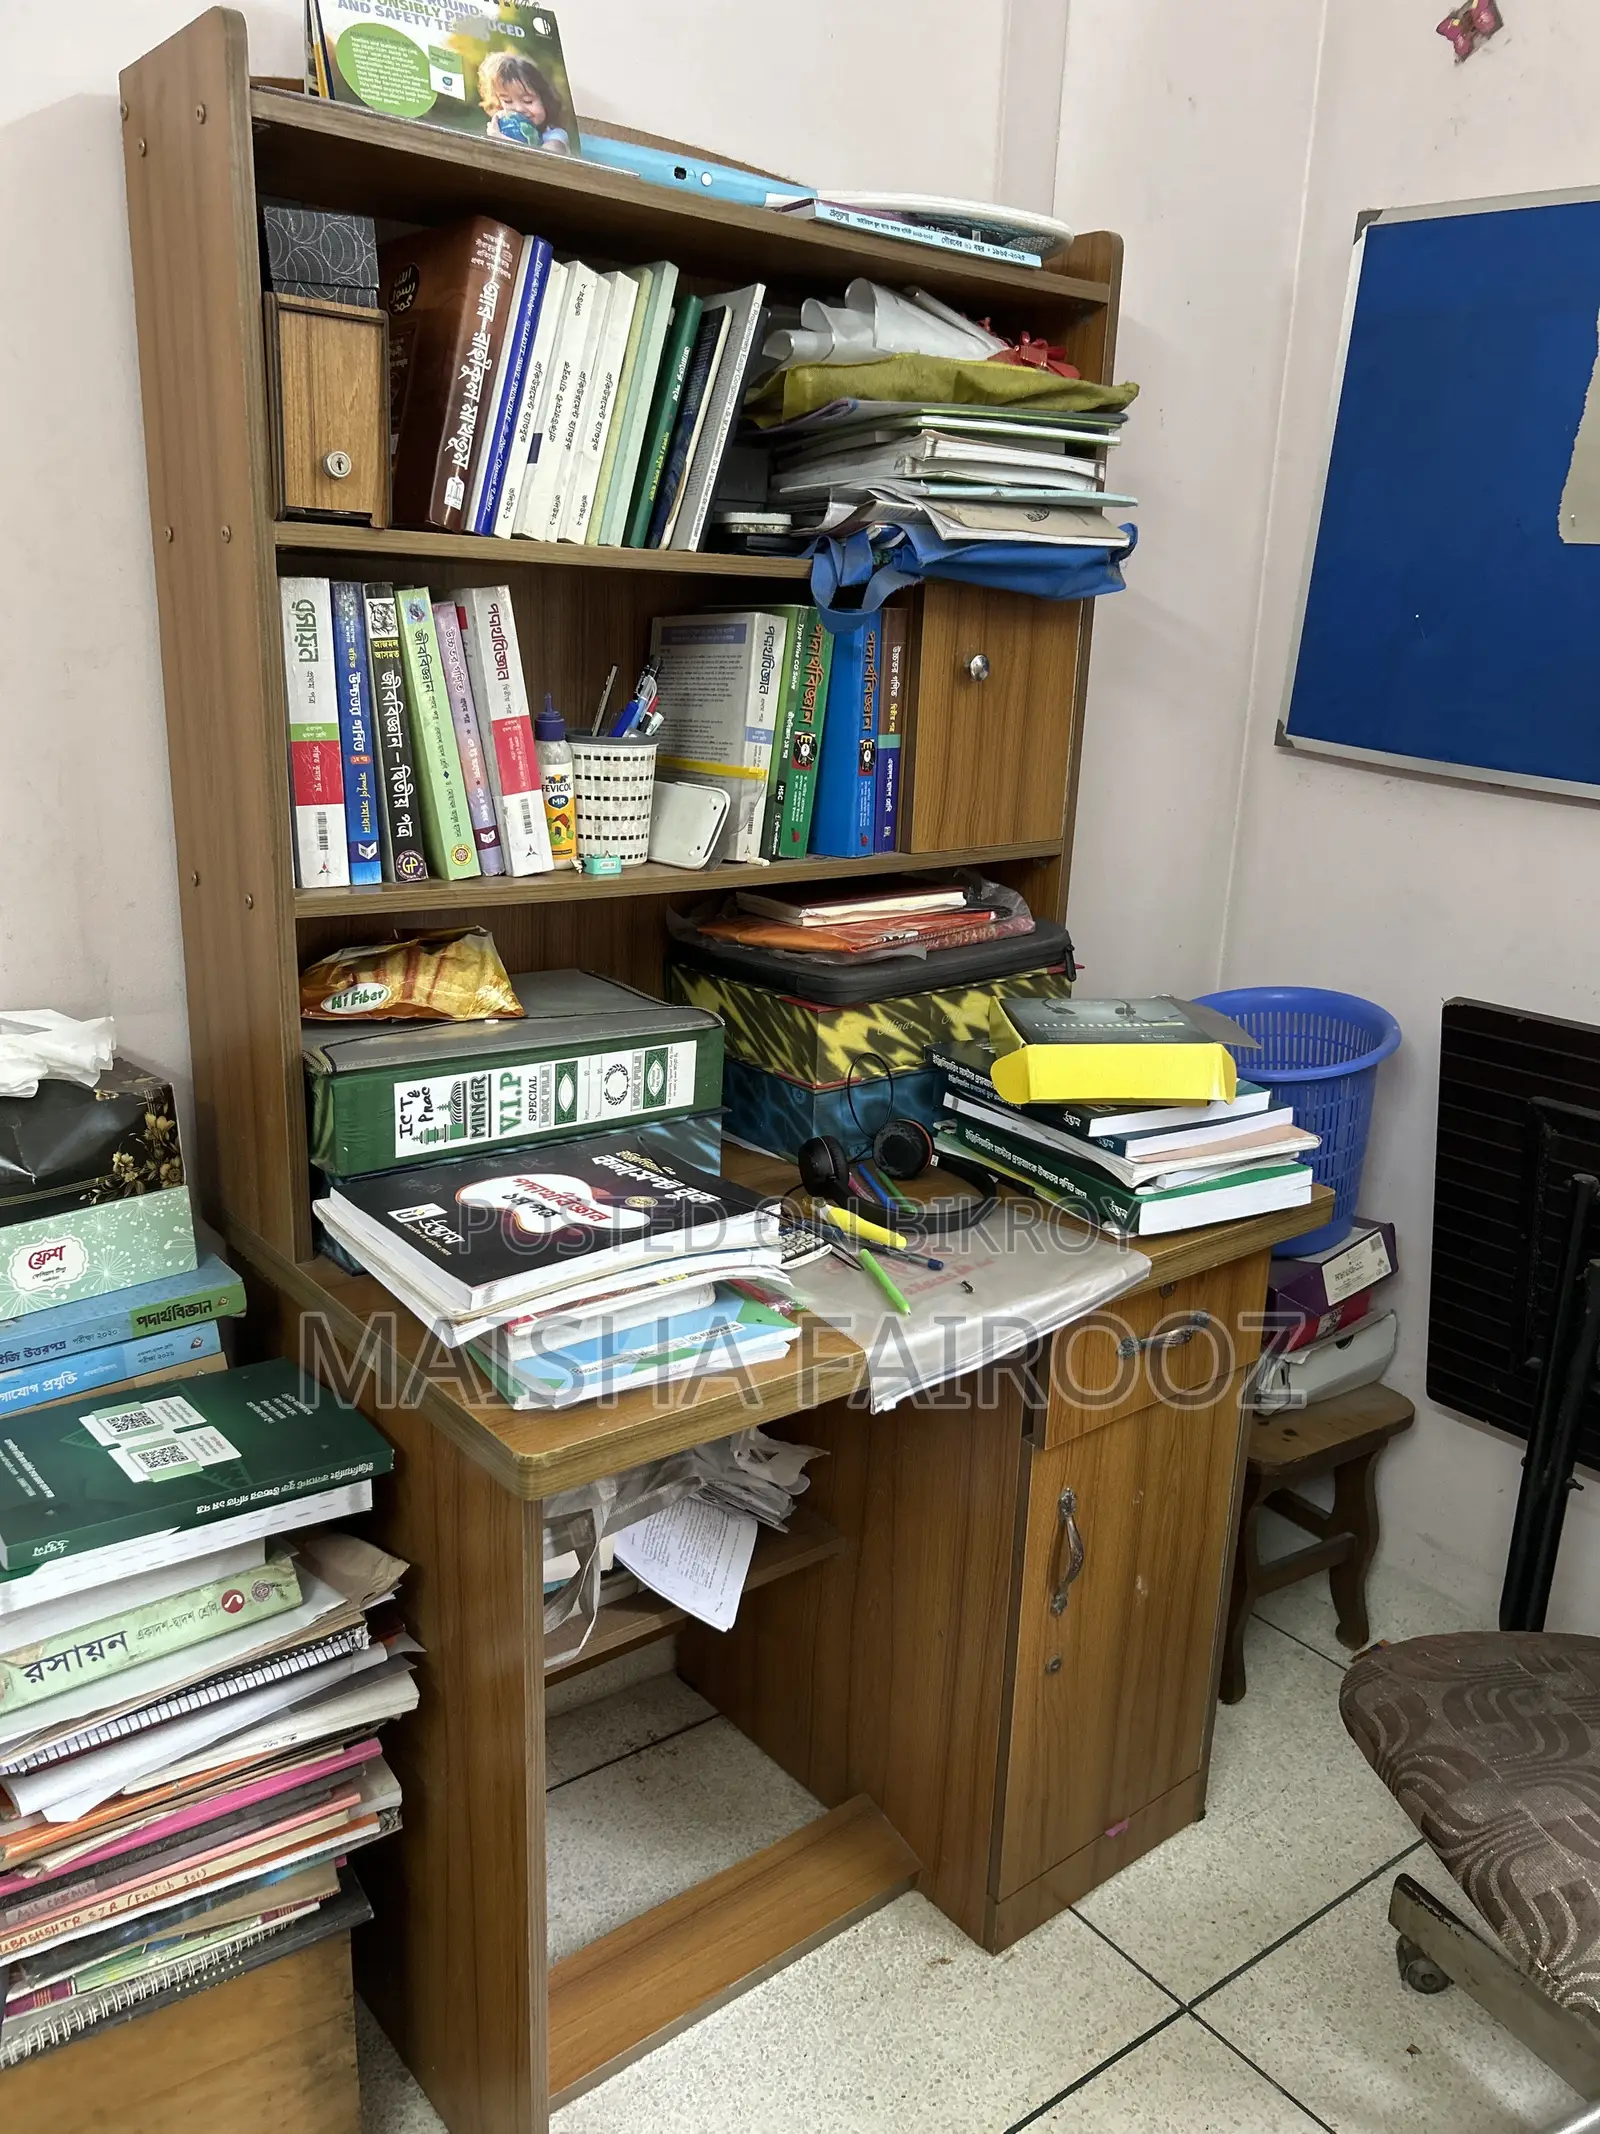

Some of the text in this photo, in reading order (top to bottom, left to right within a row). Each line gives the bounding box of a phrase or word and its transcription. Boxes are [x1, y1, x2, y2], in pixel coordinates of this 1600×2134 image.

[338, 0, 371, 13] AND
[374, 5, 431, 27] SAFETY
[743, 308, 758, 353] Programming
[736, 353, 746, 373] Easily
[292, 599, 319, 663] রসায়ন
[489, 603, 509, 681] পদার্থবিজ্ঞান
[793, 641, 802, 658] Wise
[795, 623, 804, 640] Type
[415, 628, 434, 693] জীববিজ্ঞান
[444, 628, 460, 664] উচ্চতর
[452, 665, 467, 694] গণিত
[759, 626, 775, 694] পদার্থবিজ্ঞান
[790, 670, 798, 689] Solve
[803, 623, 824, 724] পদার্থবিজ্ঞান
[891, 645, 901, 673] উচ্চতর
[347, 672, 362, 716] উচ্চতর
[862, 631, 878, 731] পদার্থবিজ্ঞান
[890, 675, 899, 697] গণিত
[352, 720, 365, 752] গণিত
[380, 669, 414, 839] জীববিজ্ঞান দ্বিতীয় পত্র
[357, 773, 368, 798] সম্পূর্ণ
[541, 783, 571, 794] FEVICOL
[552, 797, 566, 806] MR
[361, 800, 370, 833] সমাধান
[330, 987, 386, 1010] Hi Fiber
[877, 1021, 916, 1036] Minar
[469, 1073, 488, 1139] MINAR
[499, 1071, 523, 1136] V.I.P
[528, 1075, 538, 1122] SPECIAL
[540, 1067, 551, 1123] BOX FILE
[399, 1096, 413, 1137] ICT
[512, 1178, 612, 1222] পদার্থবিজ্ঞান
[591, 1155, 721, 1204] কনসেপ্ট বুক
[502, 1193, 563, 1218] ১ম পত্র
[29, 1245, 66, 1269] ফ্রেশ
[23, 1340, 67, 1358] উত্তরপত্র
[72, 1334, 95, 1345] পরীক্ষা
[136, 1299, 212, 1329] পদার্থবিজ্ঞান
[42, 1371, 78, 1392] প্রযুক্তি
[20, 1601, 219, 1684] রসায়ন একাদশ-দ্বাদশ শ্রেণি
